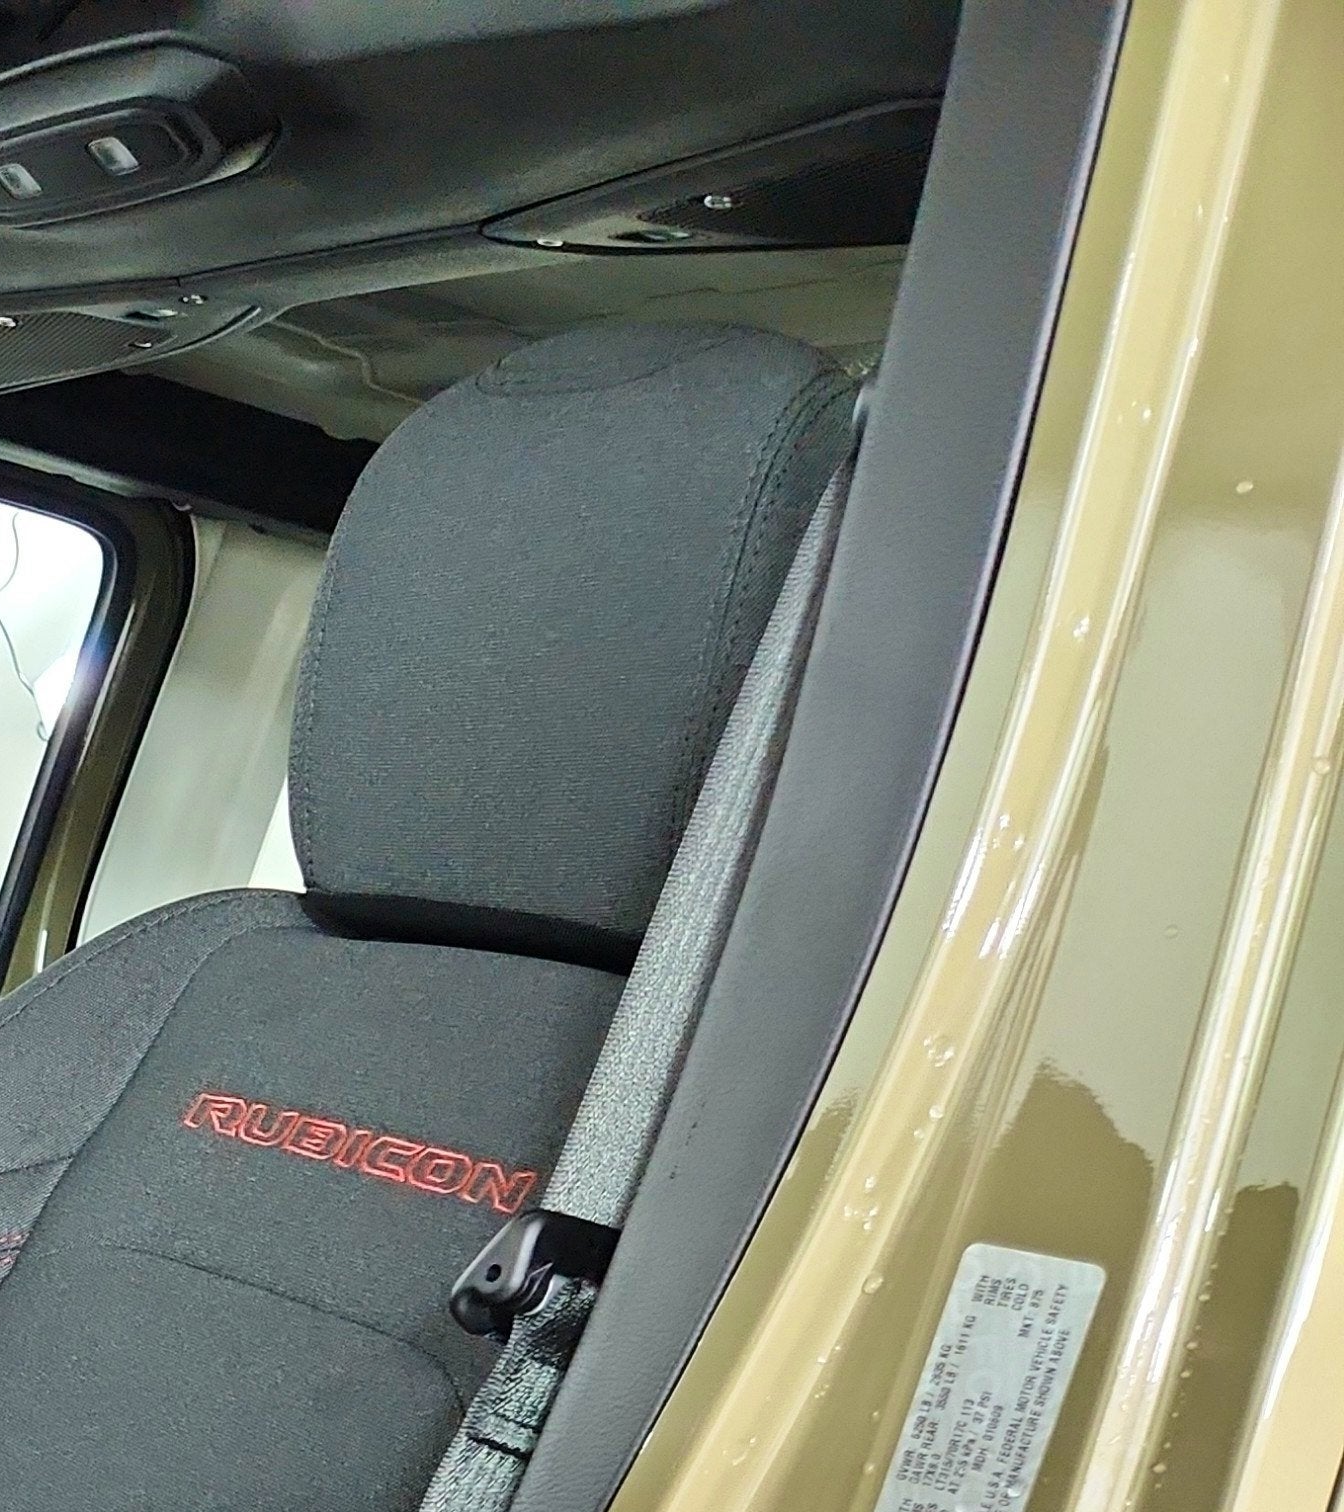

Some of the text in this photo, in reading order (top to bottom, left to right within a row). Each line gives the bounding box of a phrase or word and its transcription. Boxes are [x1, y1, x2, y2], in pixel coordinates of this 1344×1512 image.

[182, 1091, 536, 1215] RUBICON
[960, 1398, 975, 1416] 113
[997, 1277, 1016, 1307] TIRES
[983, 1279, 1002, 1305] RIMS
[908, 1452, 928, 1484] GAWR
[943, 1370, 956, 1384] LB
[962, 1315, 976, 1329] KG
[971, 1274, 989, 1302] WITH
[919, 1399, 932, 1413] LB
[939, 1344, 952, 1359] KG
[946, 1481, 960, 1494] AT
[971, 1410, 983, 1423] 37
[977, 1390, 991, 1408] PSI
[1011, 1282, 1029, 1311] COLD
[996, 1417, 1023, 1463] FEDERAL
[1014, 1375, 1036, 1412] MOTOR
[1029, 1329, 1052, 1371] VEHICLE
[1045, 1283, 1067, 1324] SAFETY
[1005, 1411, 1040, 1488] MANUFACTURE
[1034, 1367, 1056, 1406] SHOWN
[1048, 1330, 1070, 1362] ABOVE
